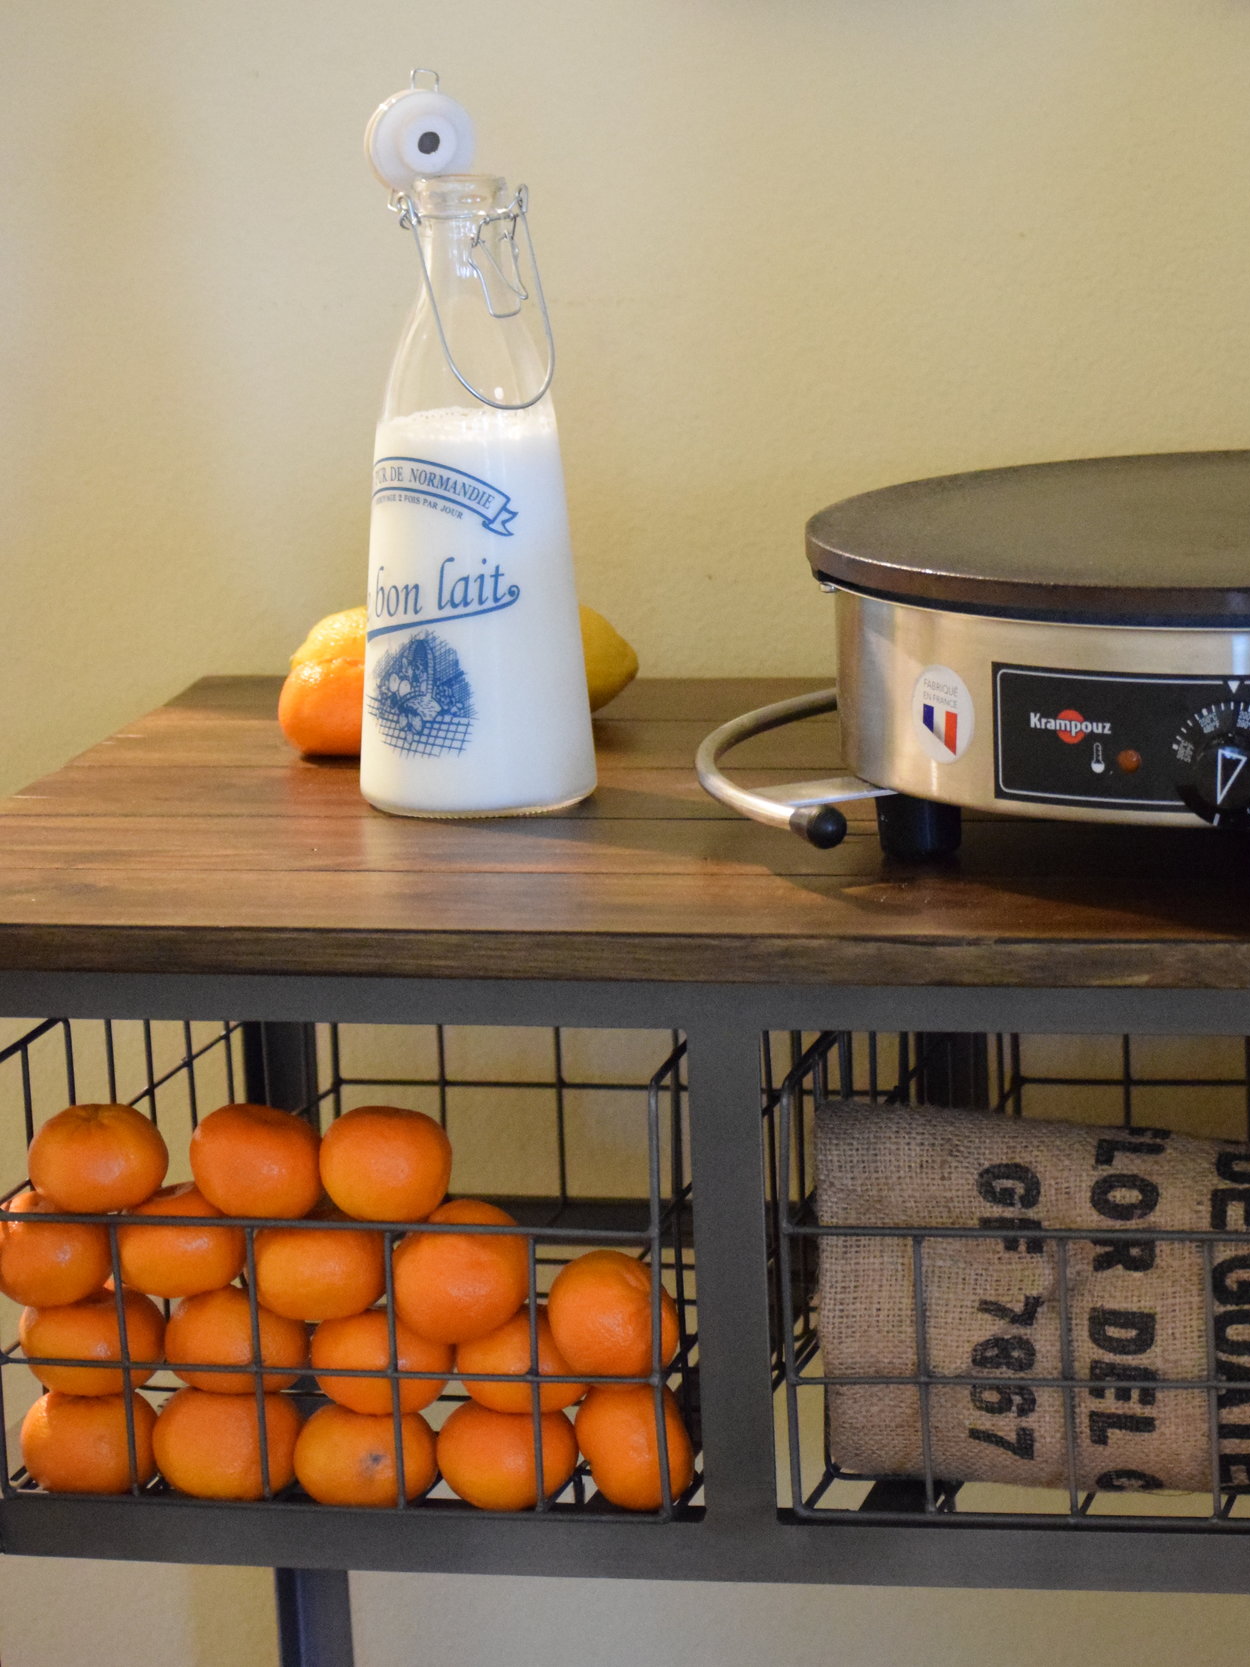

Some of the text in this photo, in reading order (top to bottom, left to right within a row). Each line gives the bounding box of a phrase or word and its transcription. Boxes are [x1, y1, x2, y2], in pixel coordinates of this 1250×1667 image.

[390, 466, 404, 482] DE
[408, 467, 495, 510] NORMANDIE
[404, 495, 421, 505] FOIS
[422, 498, 438, 510] PAR
[440, 505, 464, 519] JOUR
[375, 556, 507, 617] bon lait
[1030, 712, 1111, 736] Krampouz
[1090, 1127, 1171, 1273] LOR
[1088, 1306, 1157, 1446] DEL
